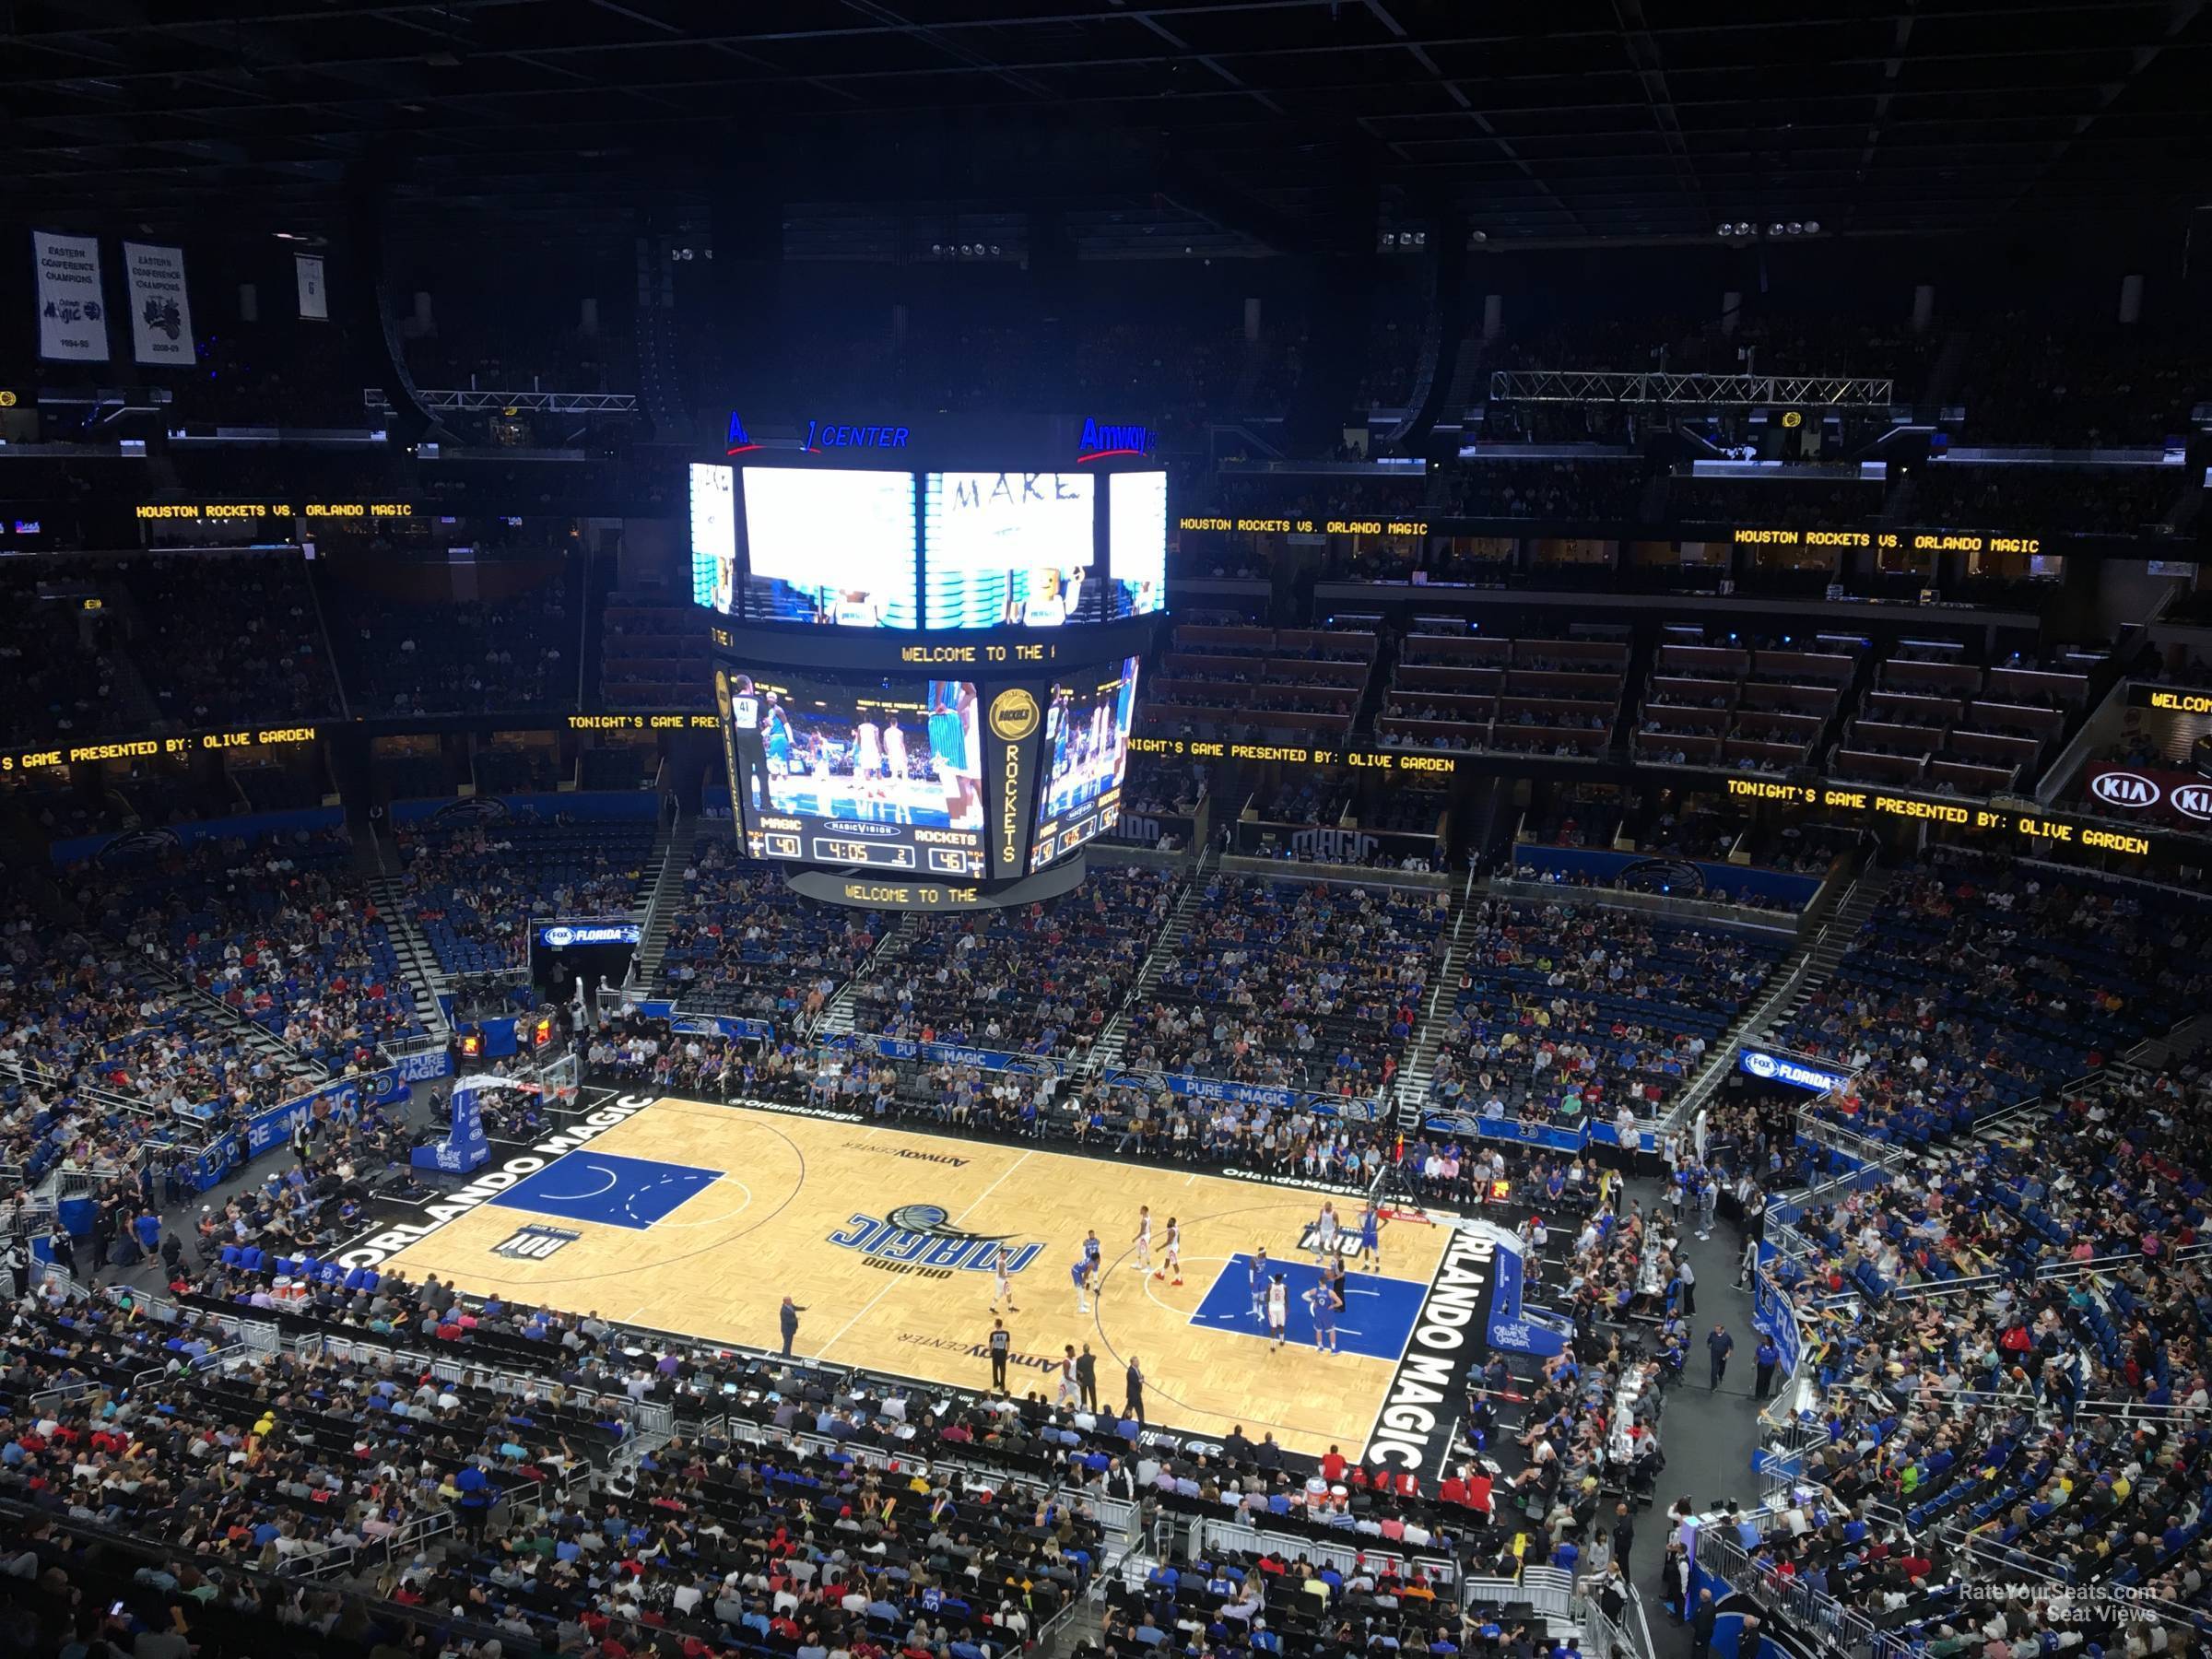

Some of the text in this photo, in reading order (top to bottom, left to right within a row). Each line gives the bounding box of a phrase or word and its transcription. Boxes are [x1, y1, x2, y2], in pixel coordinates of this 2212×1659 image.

[48, 247, 85, 258] EASTERN
[139, 256, 171, 267] EASTERN
[41, 258, 94, 271] CONFERENCE
[133, 267, 181, 278] CONFERENCE
[46, 272, 92, 284] CHAMPIONS
[135, 280, 180, 291] CHAMPIONS
[821, 426, 910, 447] CENTER
[1079, 417, 1147, 457] Amway
[952, 473, 1080, 511] MAKE
[136, 504, 412, 518] HOUSTON ROCKETS VS. ORLANDO MAGIC
[1180, 518, 1429, 535] HOUSTON ROCKETS VS. ORLANDO MAGIC
[1735, 531, 2040, 553] HOUSTON ROCKETS VS. ORLANDO MAGIC
[901, 647, 976, 662] WELCOME
[986, 646, 1006, 661] TO
[1016, 645, 1043, 660] THE
[739, 700, 748, 712] 41
[568, 716, 643, 728] TONIGHT'S
[651, 716, 684, 728] GAME
[22, 751, 62, 769] GAME
[70, 741, 159, 762] PRESENTED
[166, 738, 194, 753] BY:
[203, 733, 251, 748] OLIVE
[259, 728, 315, 745] GARDEN
[1191, 743, 1224, 757] GAME
[1231, 745, 1307, 763] PRESENTED
[1314, 750, 1339, 764] BY:
[1348, 753, 1392, 769] OLIVE
[1401, 756, 1454, 772] GARDEN
[2102, 778, 2147, 802] KIA
[1003, 745, 1019, 863] ROCKETS
[2183, 789, 2212, 813] KI
[760, 818, 802, 830] MAGIC
[1727, 780, 2149, 855] TONIGHT'S GAME PRESENTED BY: OLIVE GARDEN
[776, 839, 795, 853] 40
[914, 830, 977, 846] ROCKETS
[830, 842, 868, 862] 4:05
[898, 849, 905, 860] 2
[940, 853, 960, 870] 46
[844, 885, 977, 903] WELCOME TO THE
[575, 929, 621, 941] FLORIDA
[409, 1053, 446, 1069] PURE
[896, 1043, 986, 1066] PUE MAGIC
[1753, 1058, 1830, 1089] FOX FLORIDA
[1185, 1081, 1288, 1106] PURE MAGIC
[289, 1089, 356, 1132] MGIC
[728, 1098, 864, 1122] @OrlandoMagic
[841, 1141, 901, 1156] CENTER
[896, 1148, 971, 1168] Amway
[339, 1095, 654, 1270] ORLANDO MAGIC
[1222, 1168, 1412, 1203] OrlandoMagic.m
[495, 1233, 568, 1257] RDV
[827, 1213, 1048, 1274] MAGIC
[862, 1256, 953, 1279] ORLANDO
[1318, 1298, 1325, 1306] 9
[1493, 1325, 1517, 1337] Olive
[898, 1333, 970, 1351] CENTER
[1496, 1335, 1530, 1349] Garden
[964, 1344, 1064, 1373] Amay
[1370, 1354, 1455, 1470] MAGIC
